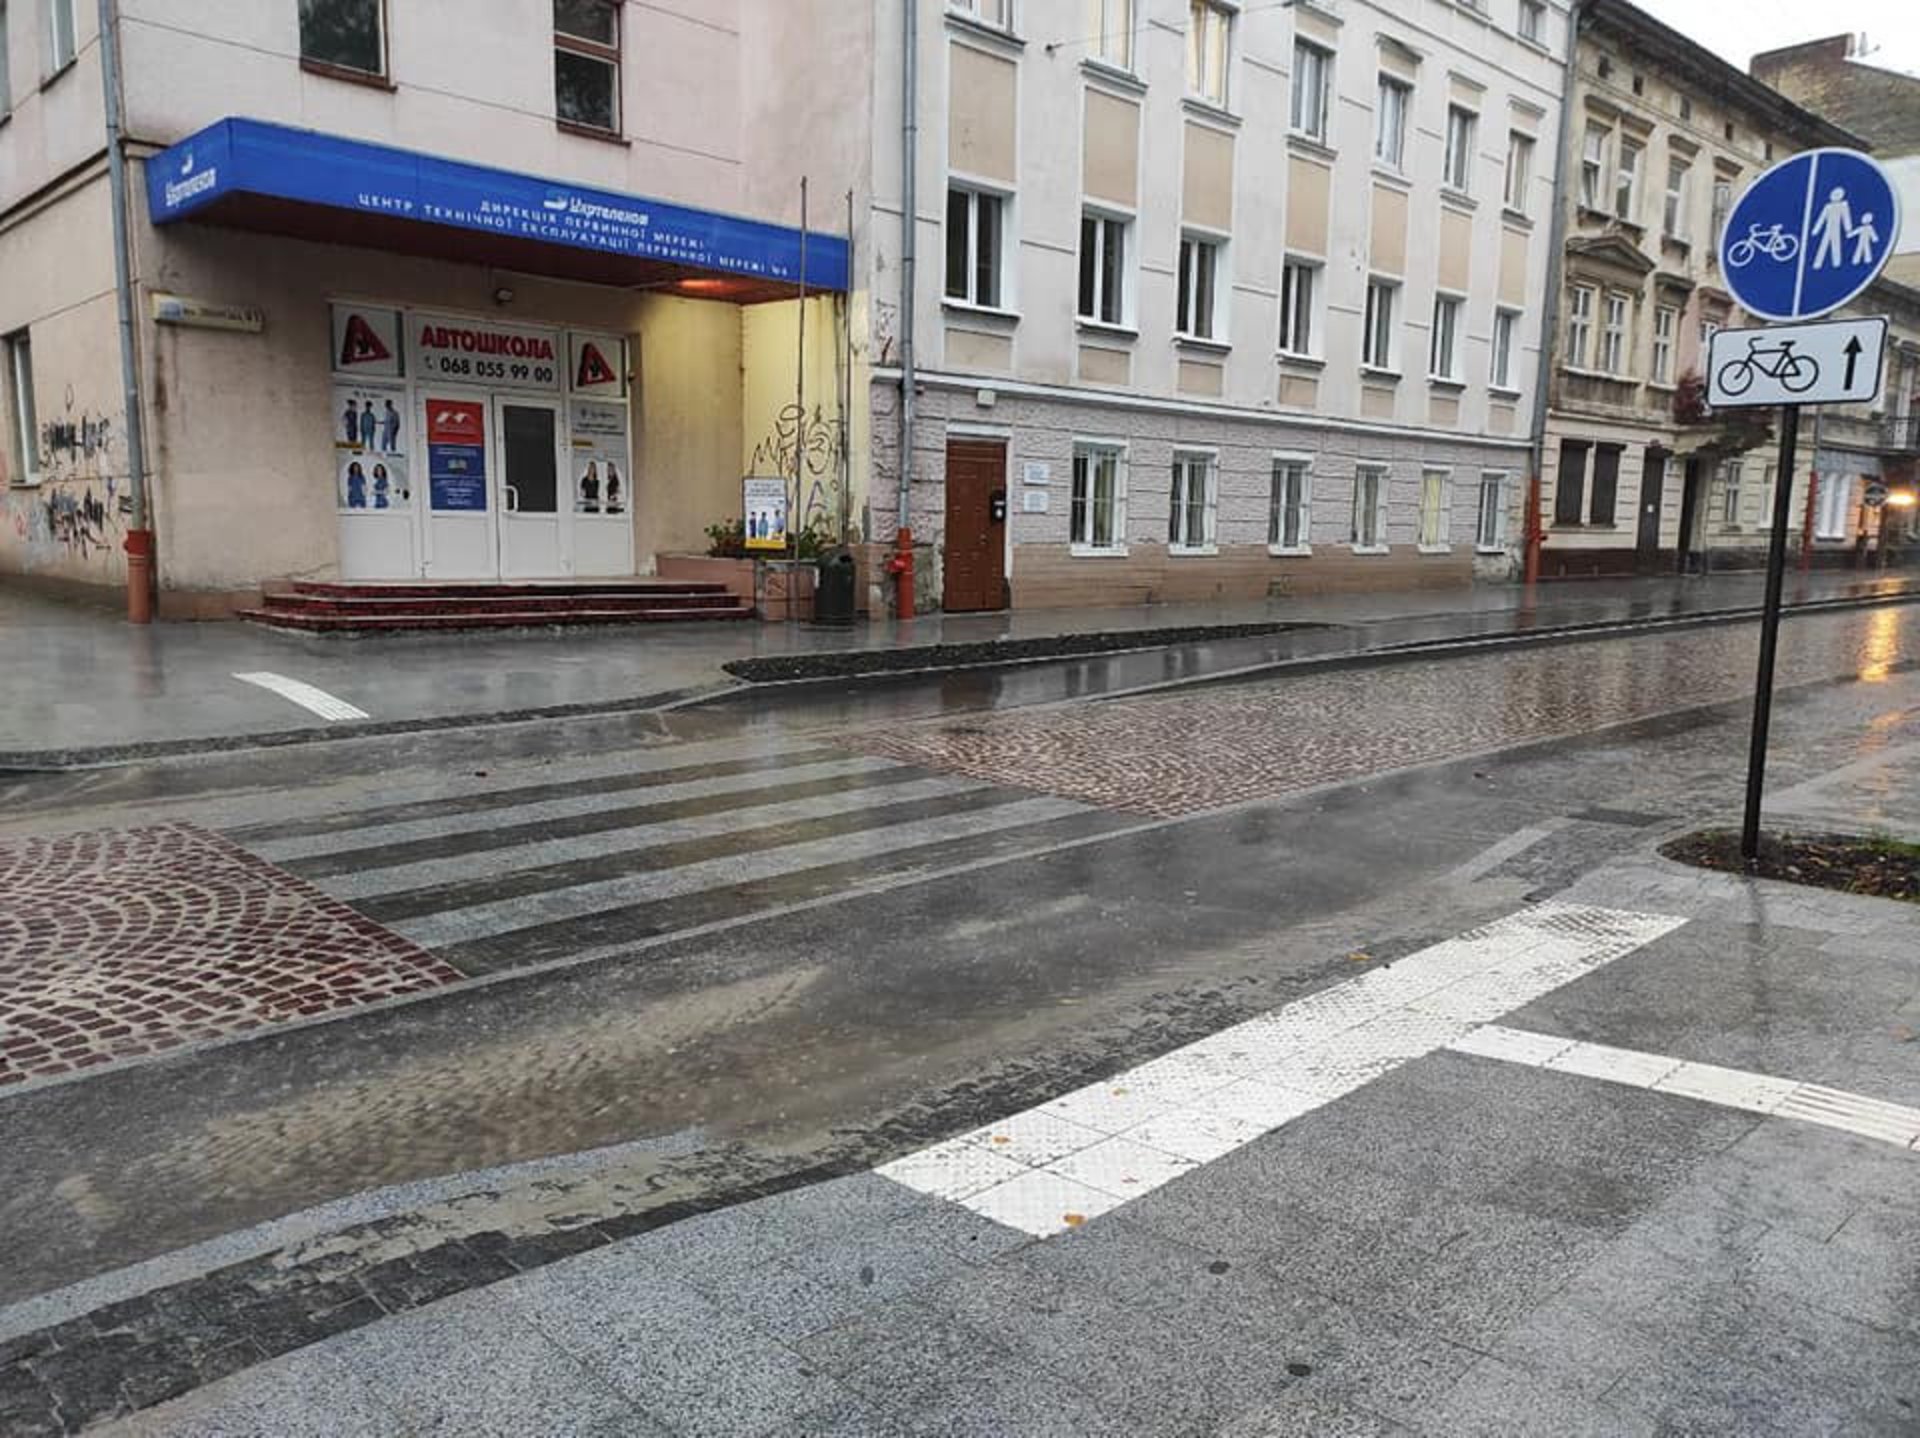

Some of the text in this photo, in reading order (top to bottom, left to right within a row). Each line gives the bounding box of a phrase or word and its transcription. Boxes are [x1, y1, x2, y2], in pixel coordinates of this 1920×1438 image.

[359, 192, 413, 211] ЦЕНТР
[420, 324, 555, 361] АВТОШКОЛА
[440, 356, 553, 383] 068 055 99 00
